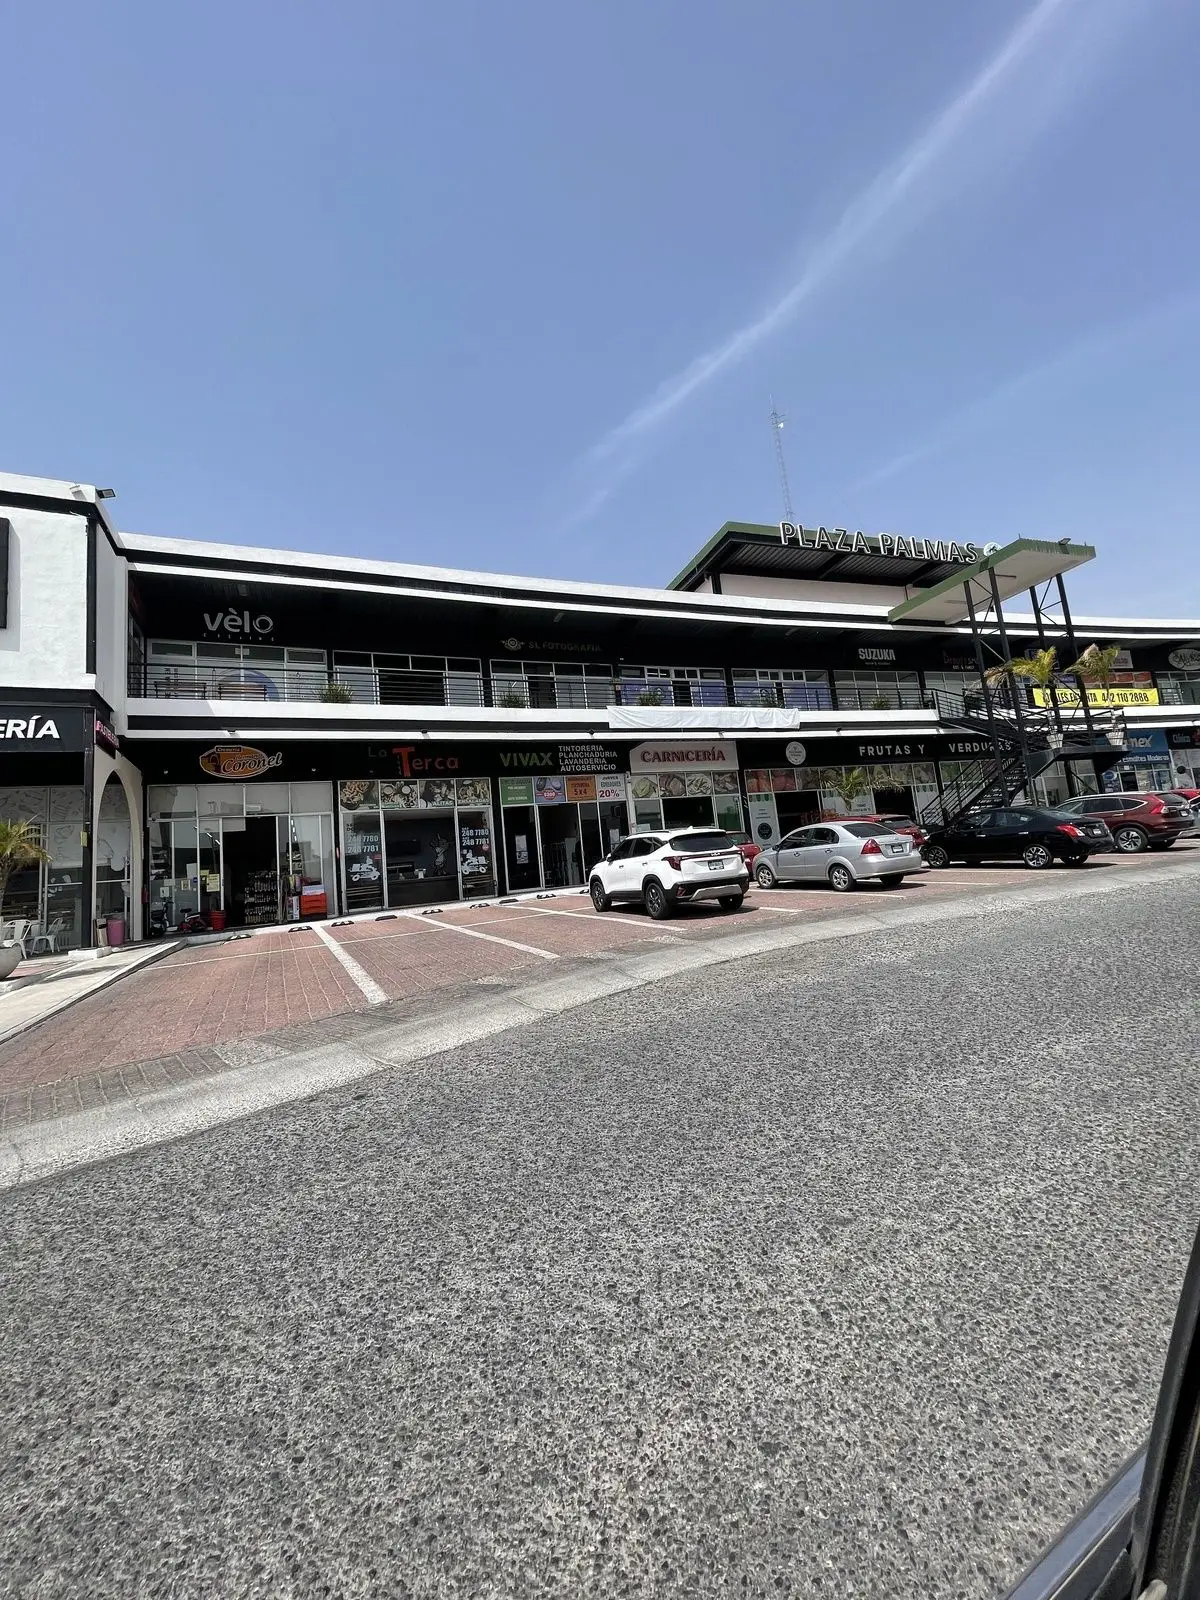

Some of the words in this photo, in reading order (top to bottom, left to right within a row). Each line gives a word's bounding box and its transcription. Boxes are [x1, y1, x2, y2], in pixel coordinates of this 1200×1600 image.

[779, 521, 871, 554] PLAZA
[878, 533, 978, 564] PALMAS
[203, 607, 274, 634] vèlo
[858, 648, 896, 661] SUZUKA
[640, 747, 726, 763] CARNICERÍA
[859, 744, 911, 756] FRUTAS
[917, 744, 925, 754] Y
[221, 752, 282, 774] Coronel
[392, 747, 459, 777] Terca
[500, 752, 553, 767] VIVAX
[600, 789, 620, 798] 20%
